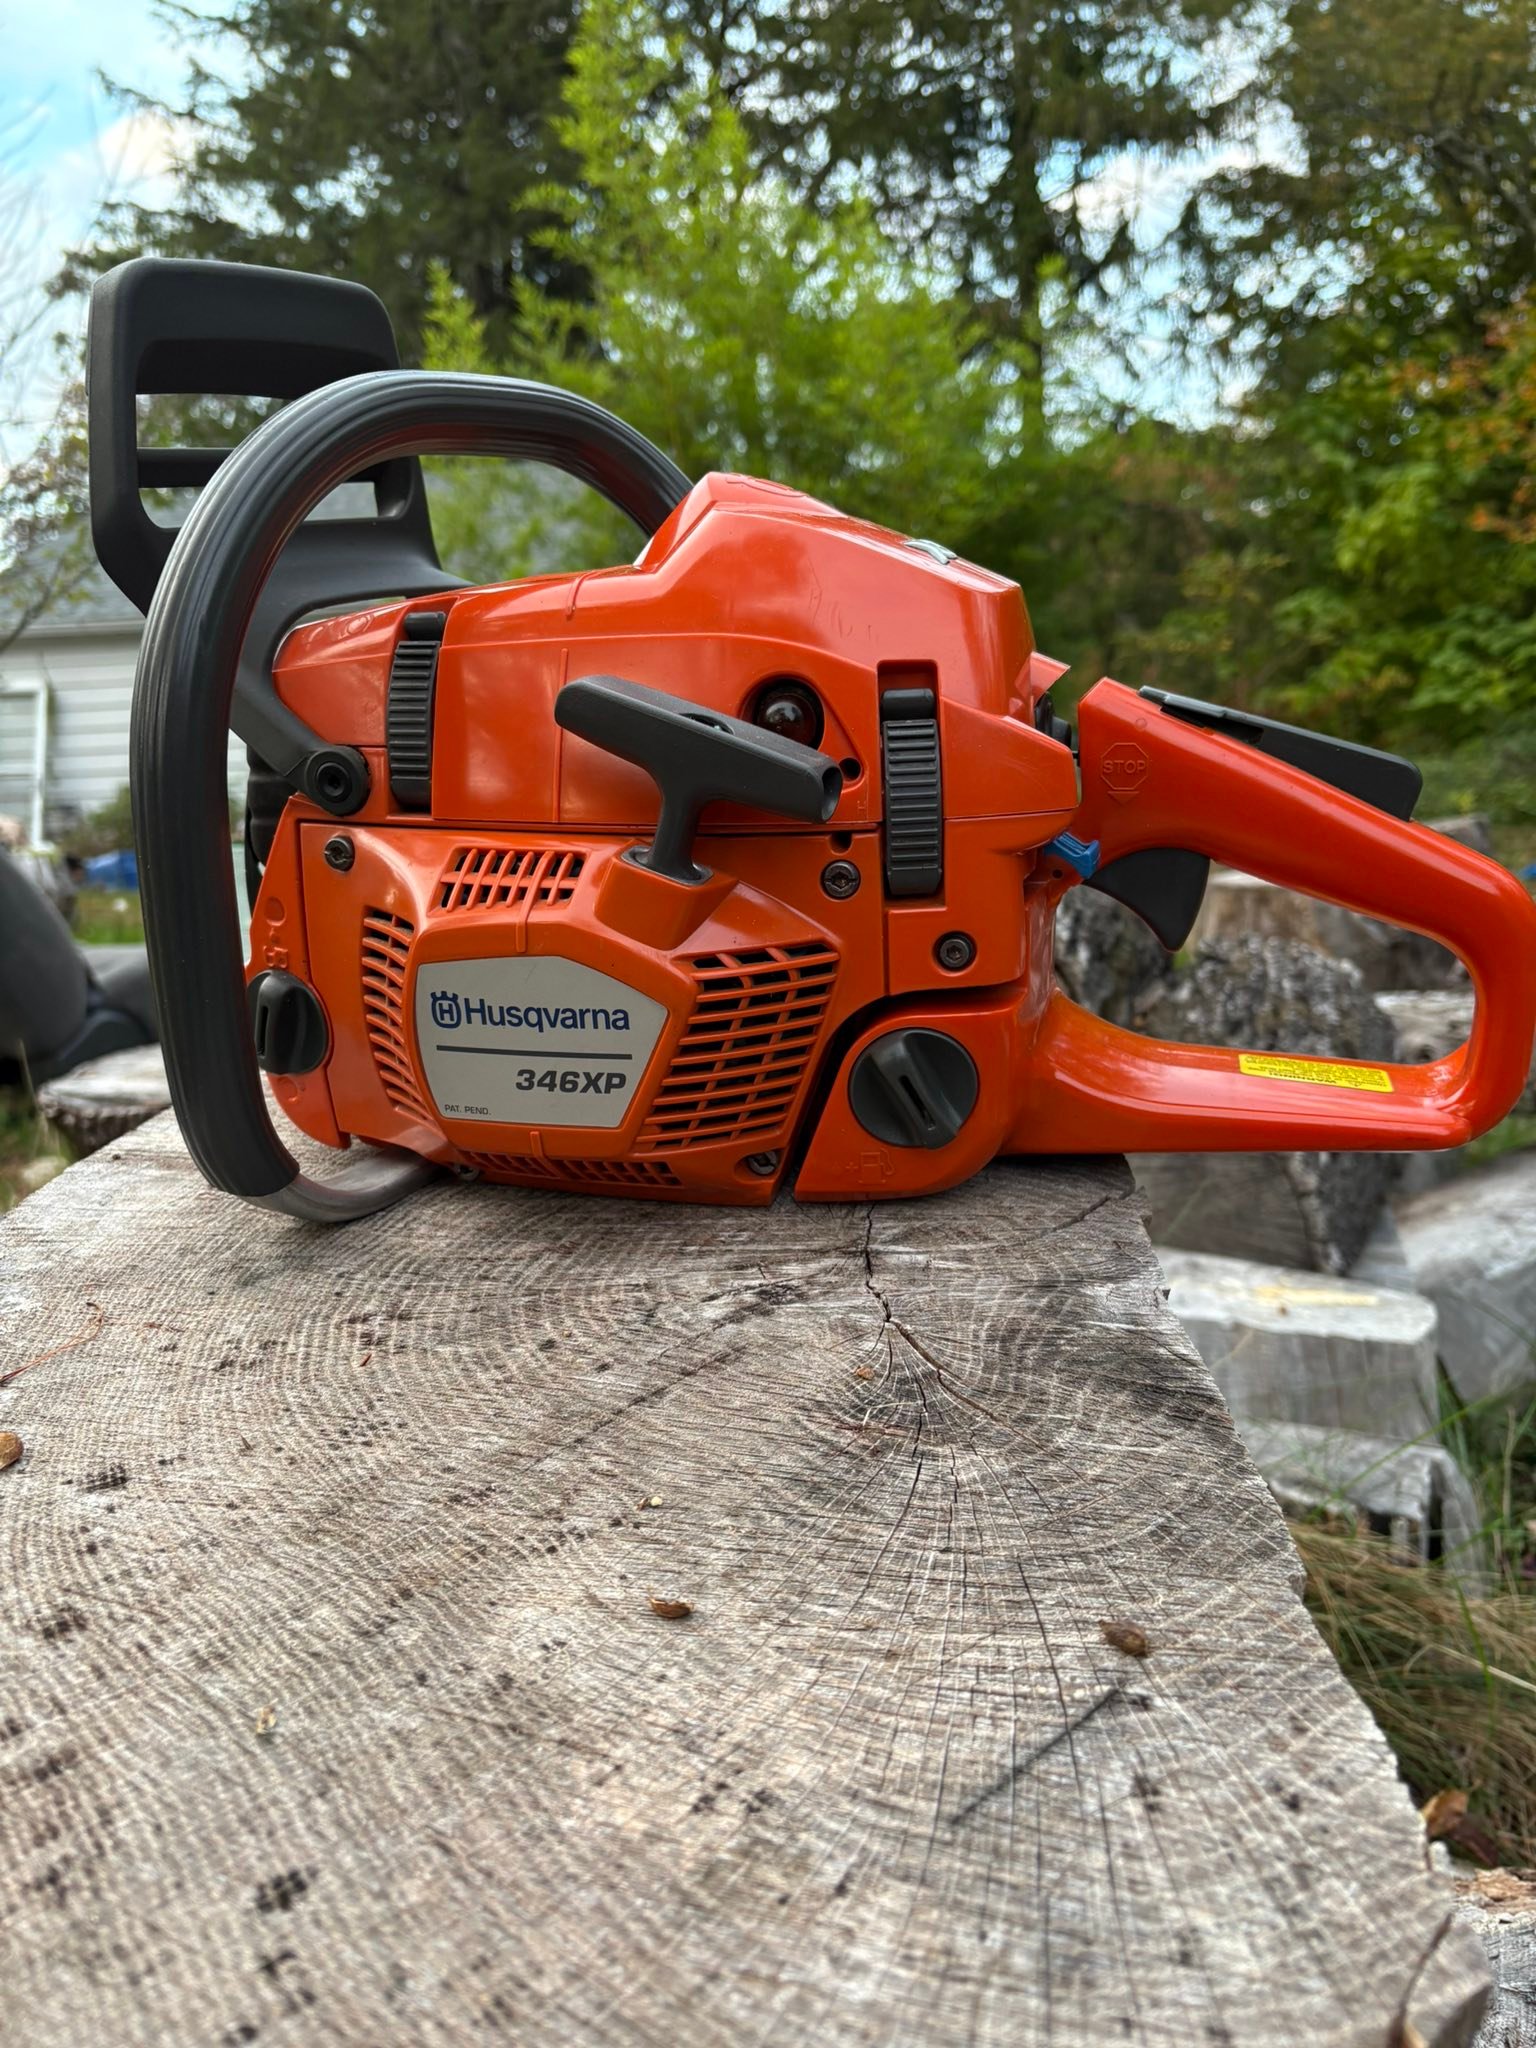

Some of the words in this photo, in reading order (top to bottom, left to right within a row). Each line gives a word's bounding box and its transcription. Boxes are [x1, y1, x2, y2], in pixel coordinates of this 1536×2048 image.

[1103, 760, 1146, 774] STOP
[463, 997, 631, 1033] Husqvarna
[515, 1069, 627, 1094] 346XP
[444, 1104, 462, 1113] PAT.
[464, 1105, 492, 1116] PEND.
